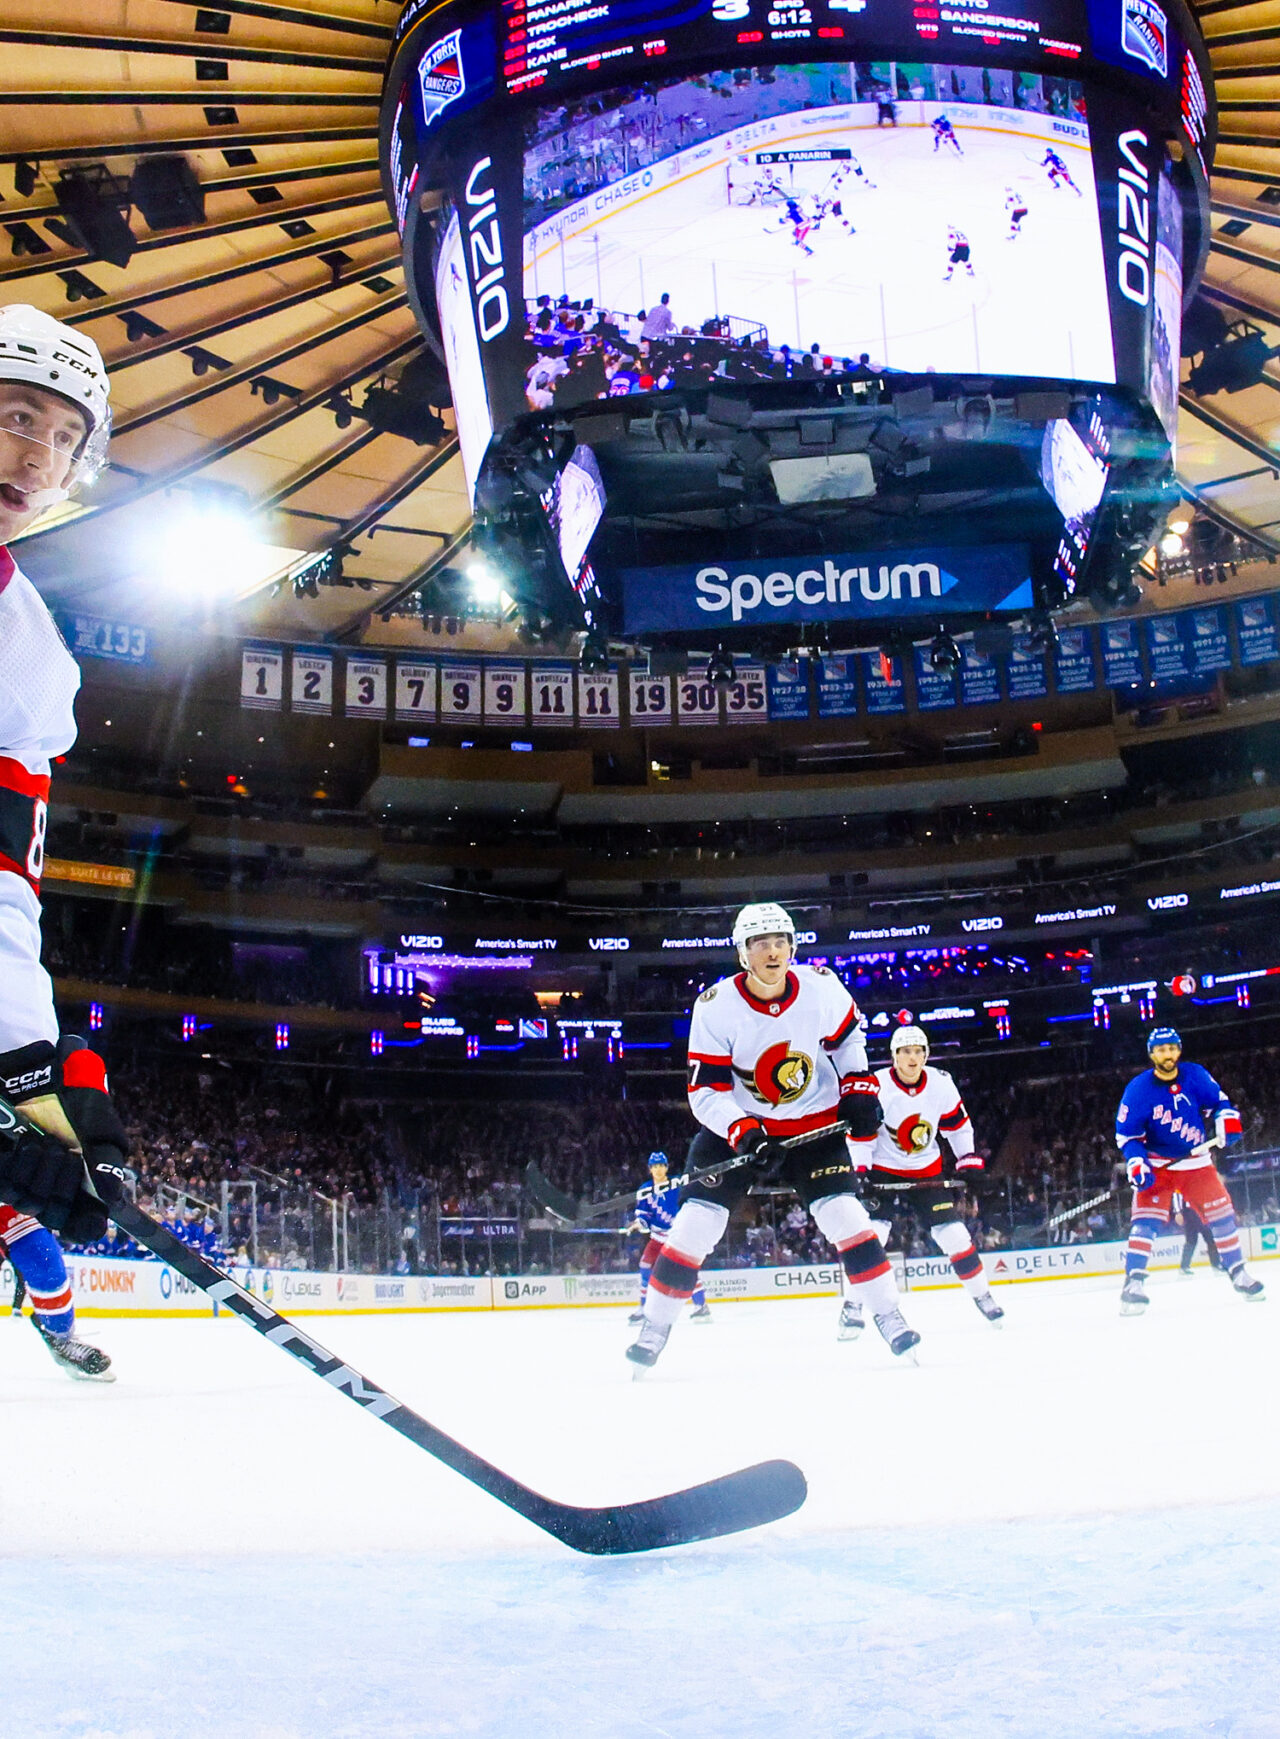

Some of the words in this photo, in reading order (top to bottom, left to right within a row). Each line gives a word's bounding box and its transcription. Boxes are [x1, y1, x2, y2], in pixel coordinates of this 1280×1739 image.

[527, 5, 609, 37] TROCHECK
[768, 9, 812, 25] 6:12
[941, 10, 1040, 33] SANDERSON
[771, 30, 811, 40] SHOTS
[916, 23, 939, 32] HITS
[952, 26, 995, 37] BLOCKED
[995, 31, 1028, 42] SHOTS
[526, 35, 557, 53] FOX
[643, 40, 665, 50] HITS
[527, 48, 567, 69] KANE
[560, 54, 602, 70] BLOCKED
[601, 46, 634, 59] SHOTS
[425, 76, 460, 93] RANGERS
[1053, 121, 1078, 136] BUD
[760, 154, 770, 163] 10
[788, 151, 832, 162] PANARIN
[595, 177, 641, 211] CHASE
[1119, 129, 1149, 306] VIZIO
[466, 156, 509, 343] VIZIO
[52, 351, 98, 379] CCM
[696, 560, 941, 621] Spectrum
[101, 623, 146, 657] 133
[255, 667, 268, 695] 1
[303, 671, 321, 700] 2
[357, 676, 375, 705] 3
[407, 679, 424, 707] 7
[452, 682, 469, 710] 9
[496, 684, 513, 712] 9
[539, 685, 565, 713] 11
[586, 686, 611, 715] 11
[635, 685, 666, 713] 19
[681, 684, 716, 711] 30
[729, 682, 764, 710] 35
[1220, 884, 1261, 899] America's
[1148, 893, 1189, 910] VIZIO
[1035, 909, 1076, 924] America's
[1076, 906, 1102, 919] Smart
[1103, 904, 1116, 915] TV
[849, 928, 890, 940] America's
[890, 925, 917, 937] Smart
[917, 925, 930, 934] TV
[962, 917, 1003, 932] VIZIO
[401, 935, 443, 948] VIZIO
[475, 938, 517, 949] America's
[517, 938, 543, 949] Smart
[543, 939, 557, 949] TV
[589, 938, 630, 950] VIZIO
[662, 938, 703, 948] America's
[704, 936, 730, 947] Smart
[422, 1018, 456, 1026] BLUES
[871, 1012, 890, 1026] 4
[4, 1065, 52, 1089] CCM
[22, 1081, 39, 1092] PRO
[841, 1081, 880, 1094] CCM
[811, 1164, 851, 1179] CCM
[636, 1174, 690, 1201] CCM
[483, 1225, 515, 1236] ULTRA
[1016, 1253, 1085, 1270] DELTA
[90, 1268, 136, 1293] DUNKIN'
[774, 1270, 843, 1287] CHASE
[293, 1283, 321, 1296] LEXUS
[206, 1278, 404, 1418] CCM
